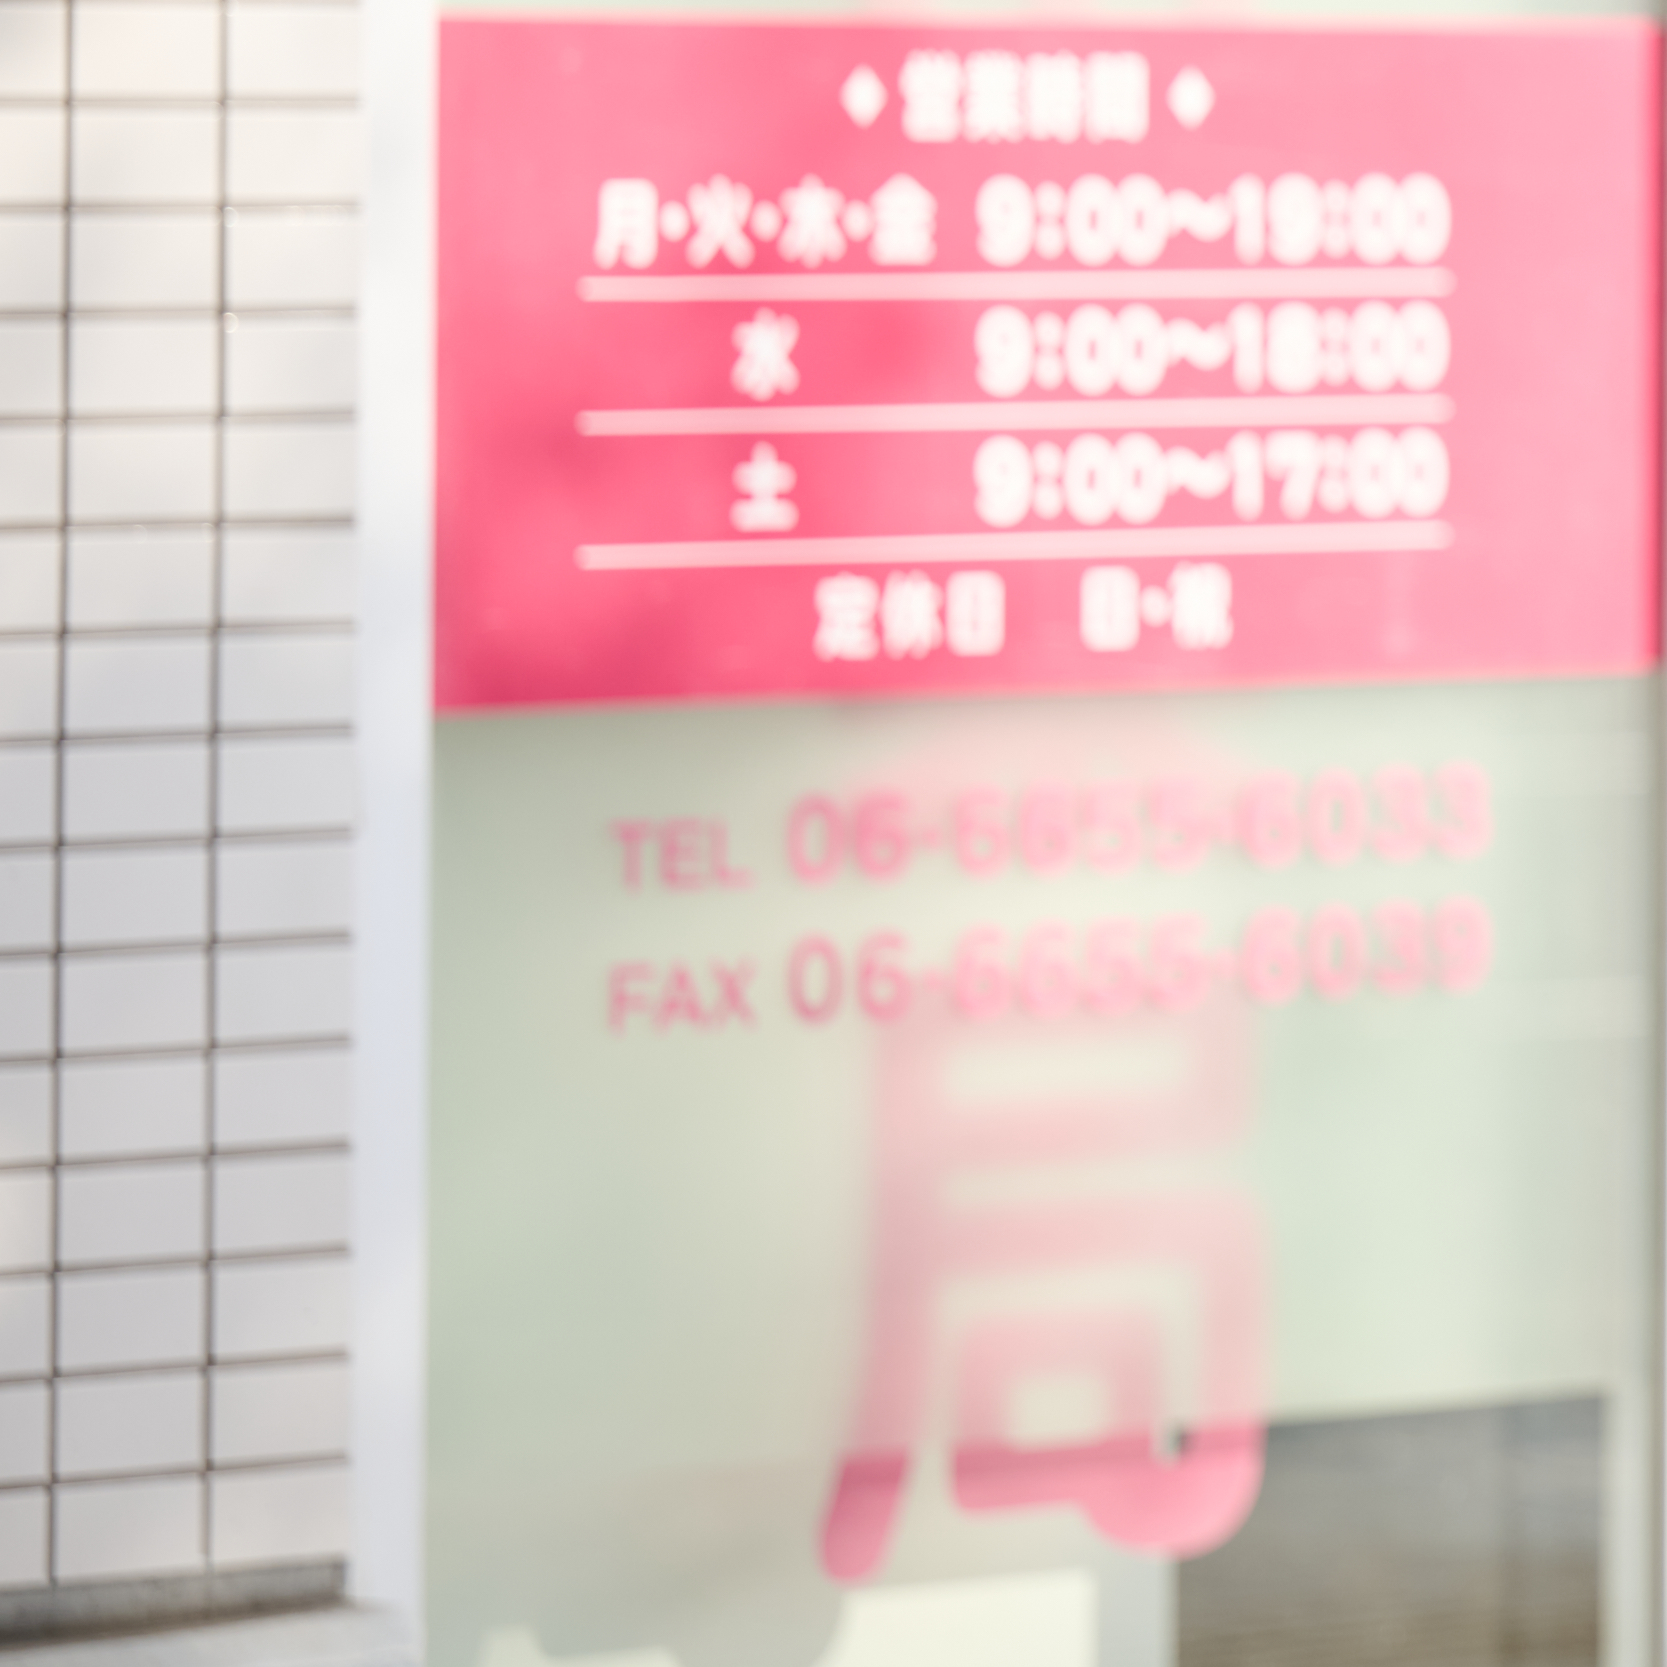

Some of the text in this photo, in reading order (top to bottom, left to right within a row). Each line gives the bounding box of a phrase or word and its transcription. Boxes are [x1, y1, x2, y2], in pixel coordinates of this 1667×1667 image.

[731, 441, 797, 532] 土
[608, 816, 756, 895] TEL
[606, 956, 758, 1036] FAX
